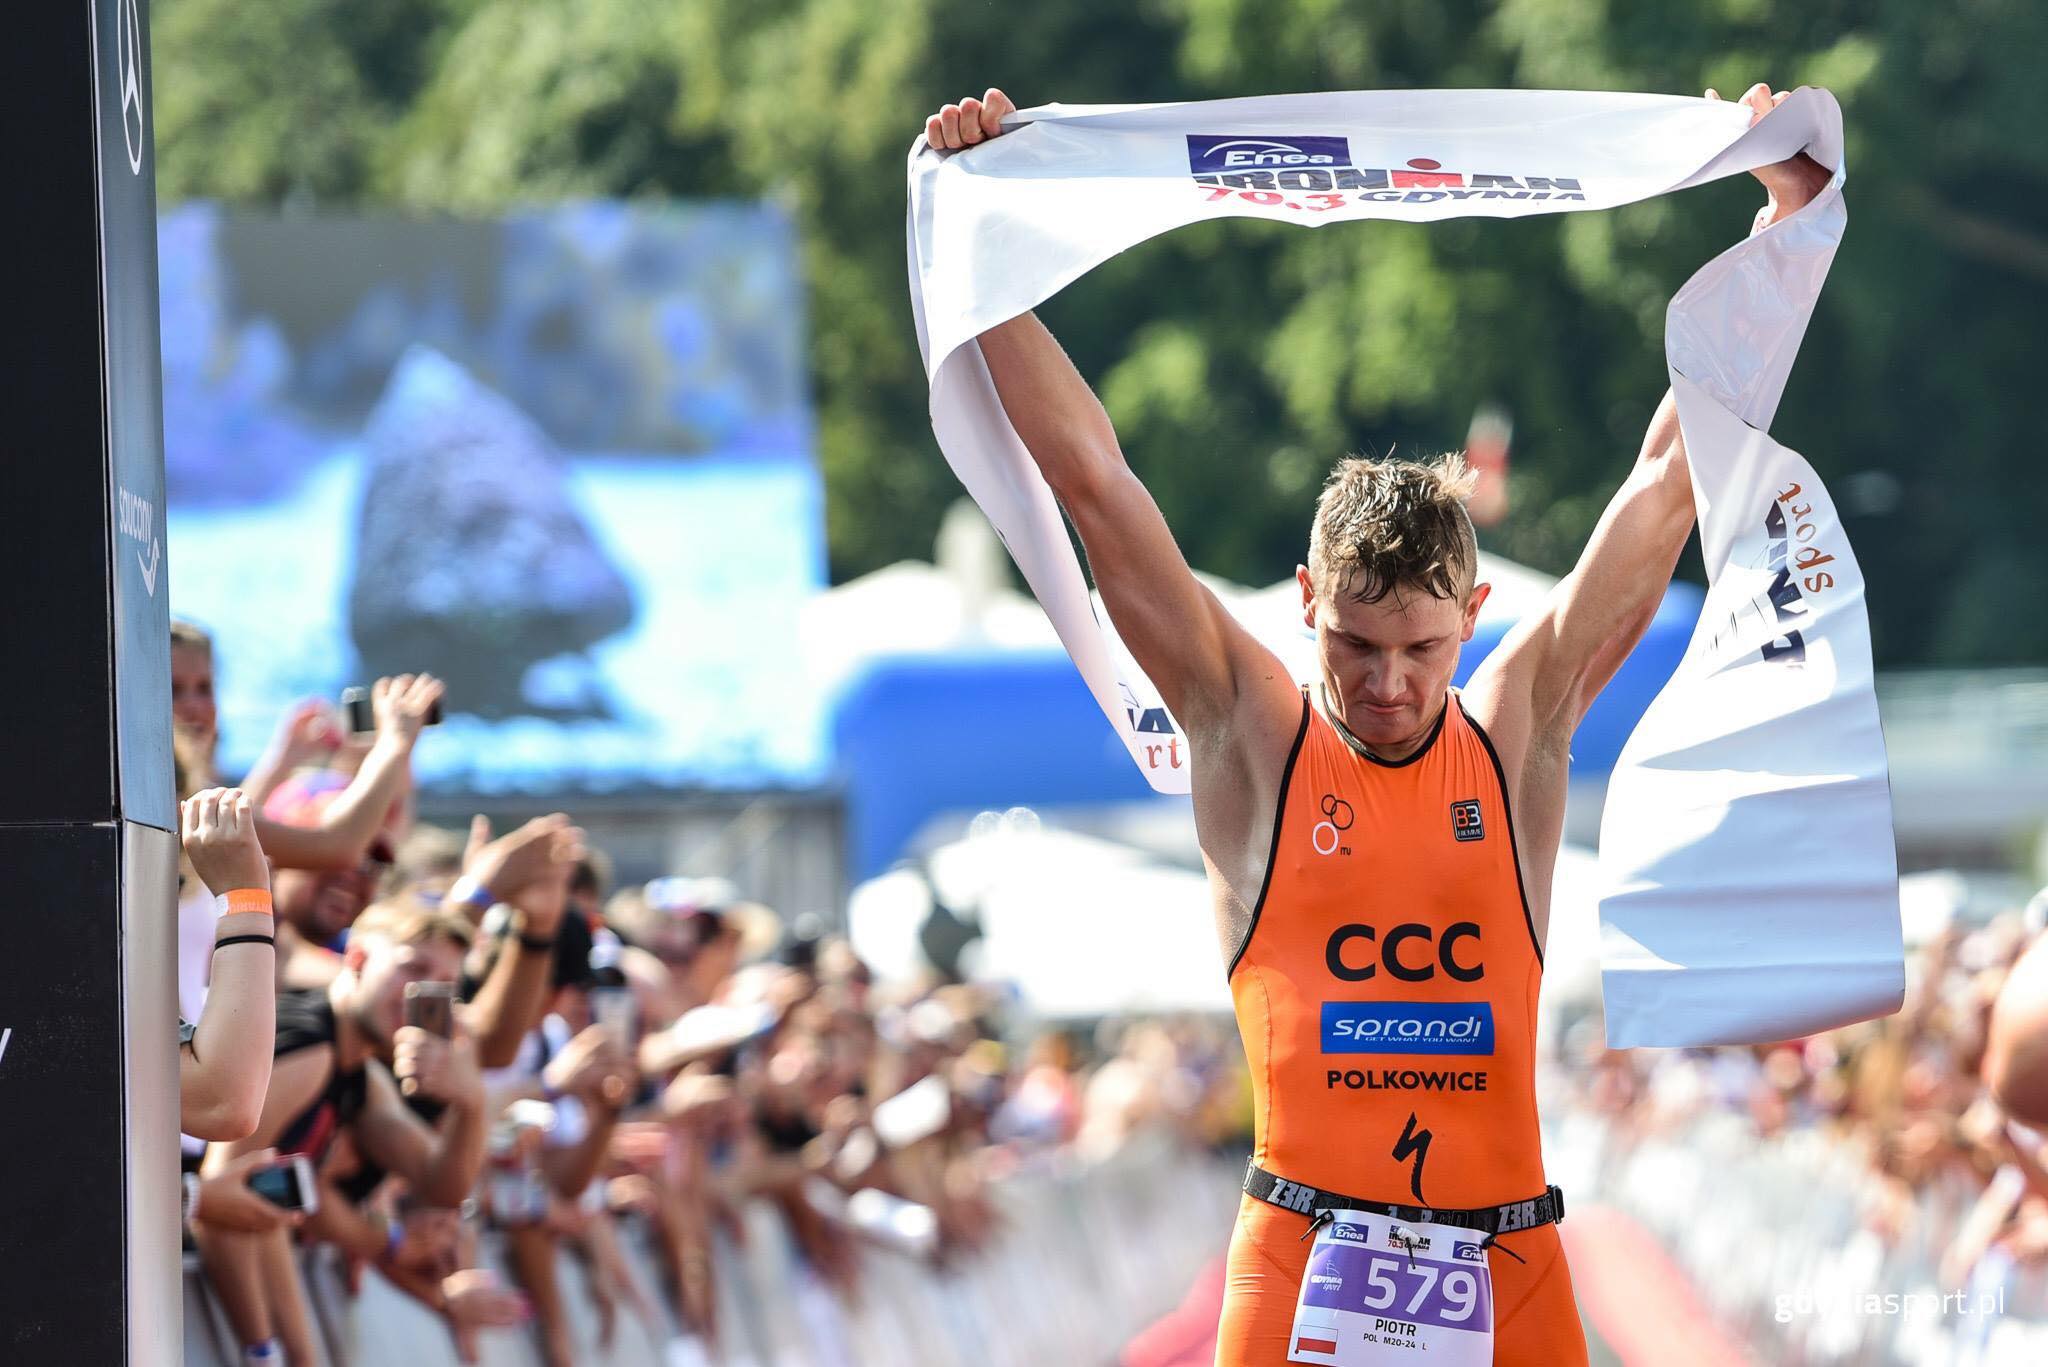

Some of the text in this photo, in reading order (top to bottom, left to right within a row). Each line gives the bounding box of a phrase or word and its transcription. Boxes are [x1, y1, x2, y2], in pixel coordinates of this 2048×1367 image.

[1224, 149, 1334, 167] Enea
[1192, 168, 1583, 191] IRONMAN
[1197, 185, 1586, 211] 70.3 GDYNIA
[1777, 482, 1836, 593] sport
[1325, 921, 1485, 983] CCC
[1332, 1016, 1482, 1040] sprandi
[1327, 1070, 1487, 1092] POLKOWICE
[1335, 1228, 1365, 1240] Enea
[1363, 1257, 1477, 1322] 579
[1375, 1318, 1416, 1337] PIOTR
[1363, 1333, 1378, 1343] POL
[1383, 1336, 1416, 1349] M20-24
